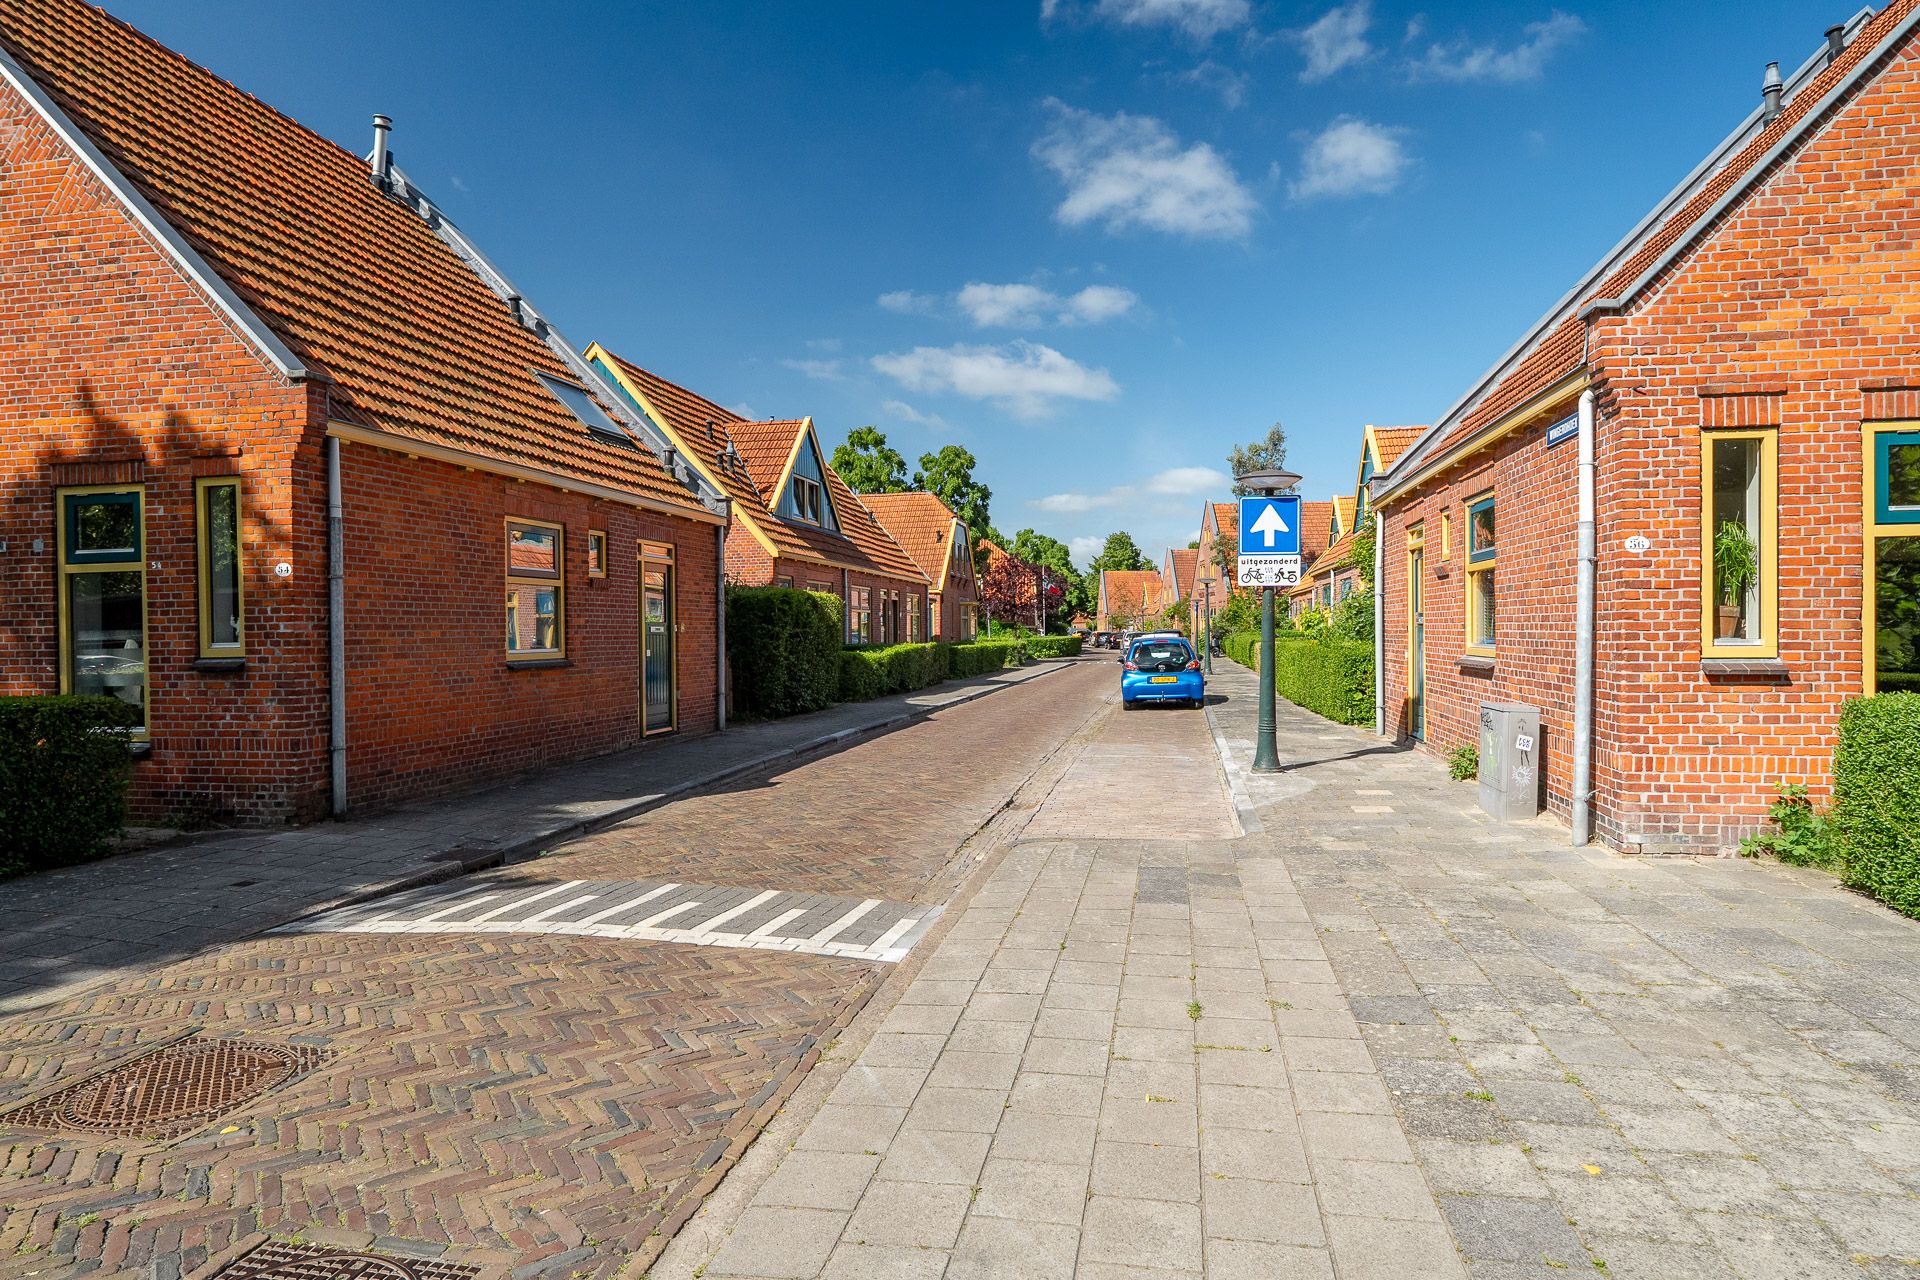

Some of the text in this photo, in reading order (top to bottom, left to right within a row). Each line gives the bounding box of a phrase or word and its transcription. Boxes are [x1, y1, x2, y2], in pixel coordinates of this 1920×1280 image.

[1629, 540, 1645, 548] 56
[151, 561, 162, 569] 54
[1241, 558, 1298, 566] uitgezonderd
[277, 566, 290, 574] 54
